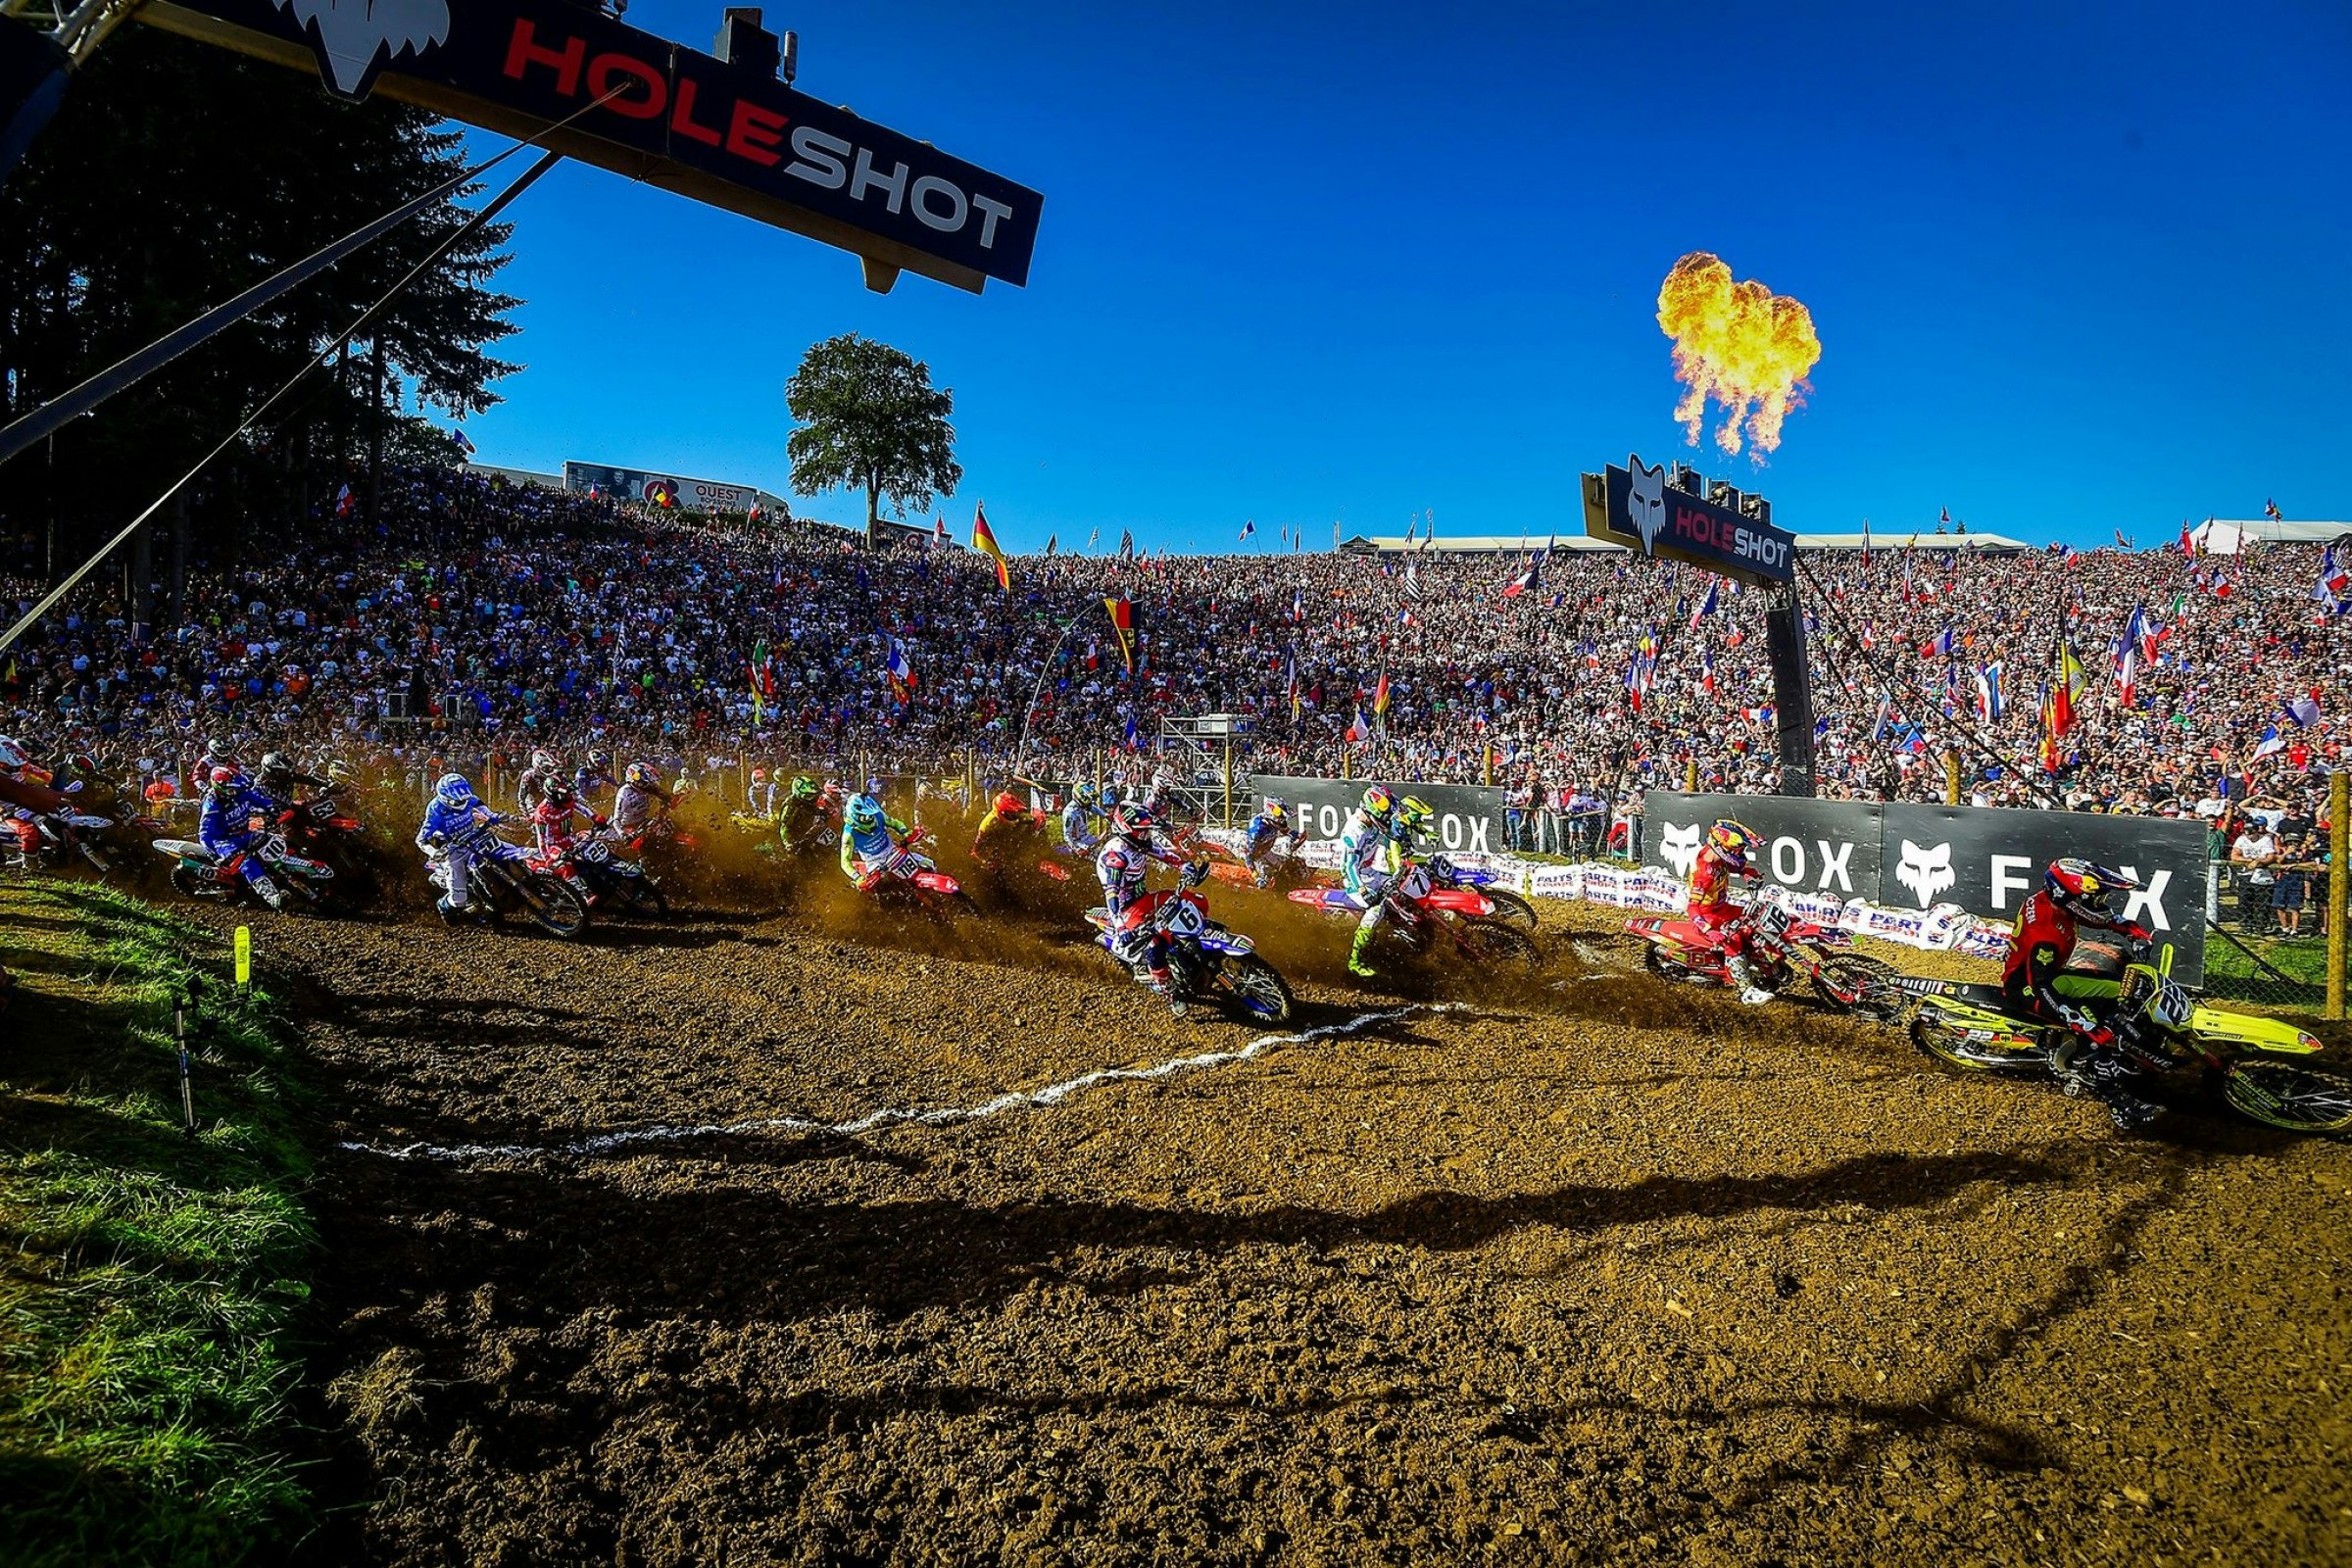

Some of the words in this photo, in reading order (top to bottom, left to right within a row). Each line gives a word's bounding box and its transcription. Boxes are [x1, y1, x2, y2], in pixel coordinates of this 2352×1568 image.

[503, 19, 1013, 249] HOLESHOT
[696, 485, 742, 501] OUEST
[1675, 506, 1788, 568] HOLESHOT
[588, 843, 608, 861] 25
[1730, 835, 1855, 893] OX
[1990, 855, 2173, 931] FX
[1178, 907, 1200, 931] 6
[1767, 906, 1789, 932] 16
[2025, 896, 2037, 924] CZEN
[1966, 1028, 1994, 1042] 22
